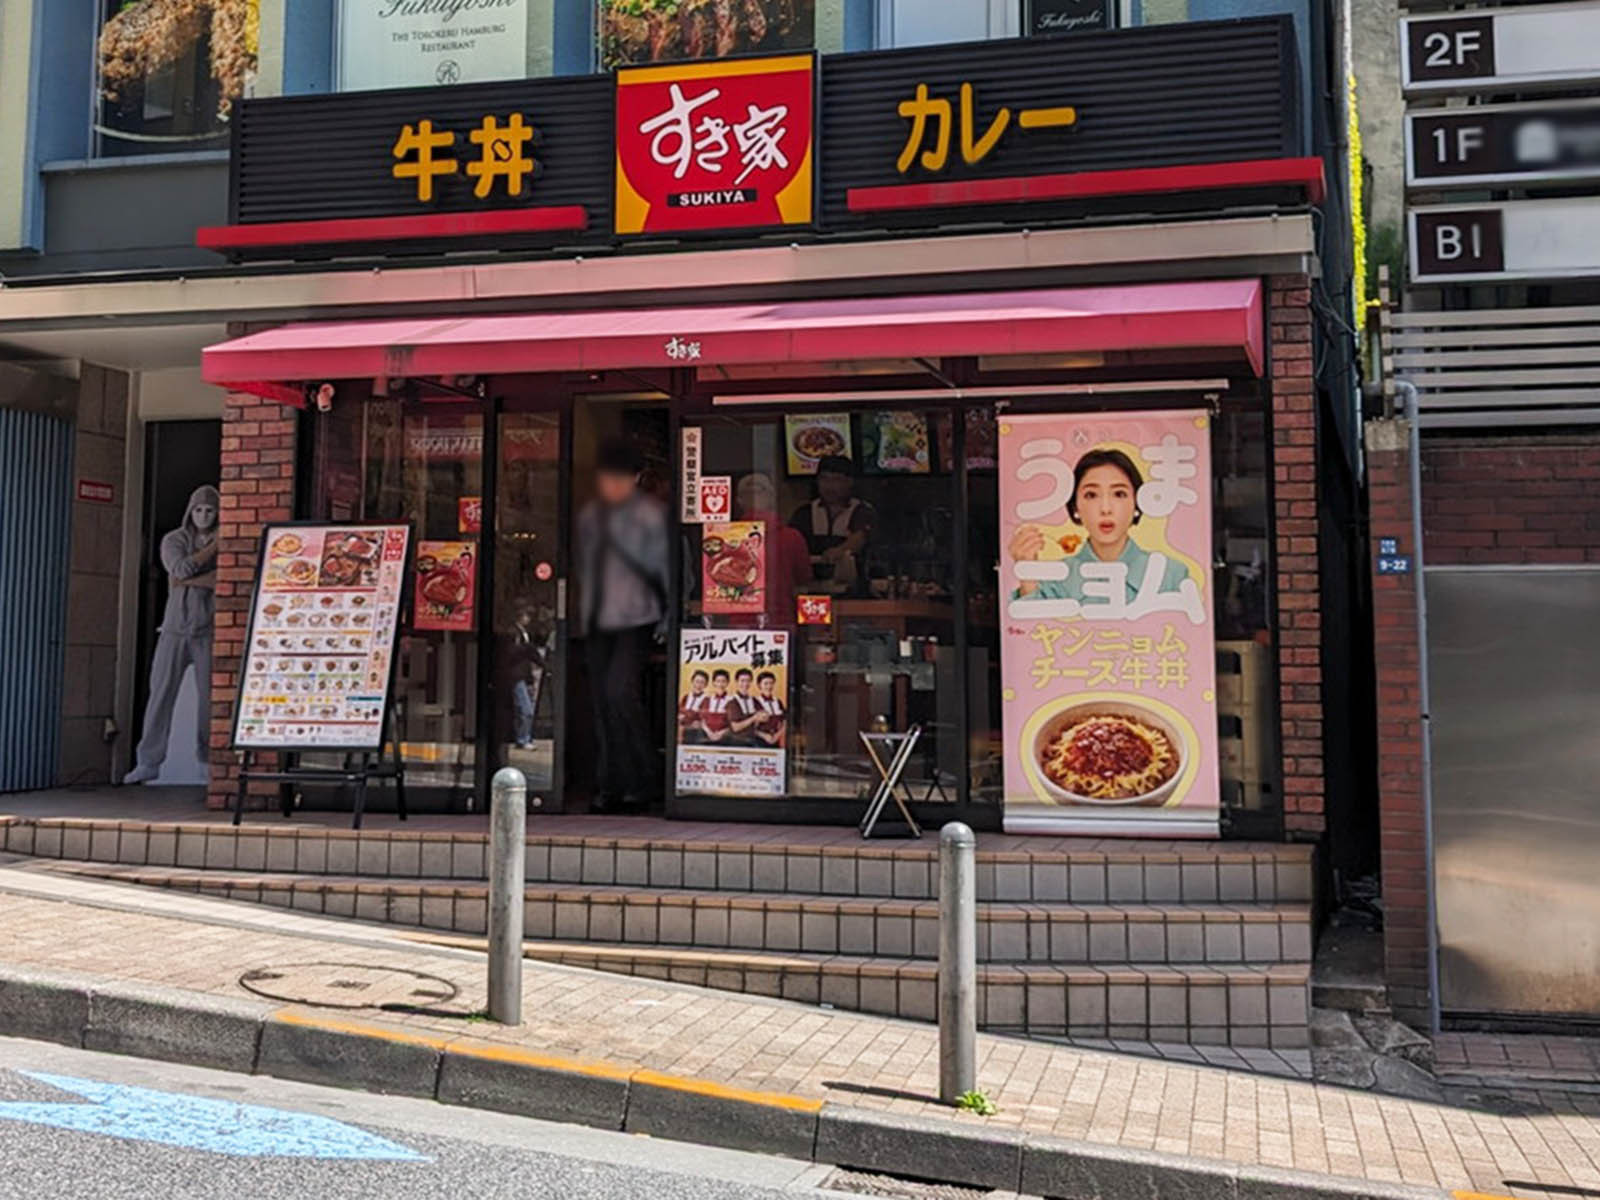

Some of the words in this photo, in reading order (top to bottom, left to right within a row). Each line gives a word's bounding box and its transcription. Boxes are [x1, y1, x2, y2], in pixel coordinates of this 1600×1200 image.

[378, 0, 517, 22] Fukuyos
[392, 32, 409, 42] THE
[460, 24, 506, 36] HAMBURG
[421, 40, 476, 53] RESTAURANT
[1424, 30, 1481, 66] 2F
[639, 83, 790, 186] すき家
[897, 82, 1076, 173] カレー
[392, 113, 534, 202] 牛丼
[1432, 127, 1484, 162] 1F
[680, 190, 746, 206] SUKIYA
[664, 337, 702, 361] すき家
[703, 486, 729, 497] AED
[684, 634, 765, 664] アルバイト
[1031, 656, 1190, 689] チーズ牛丼
